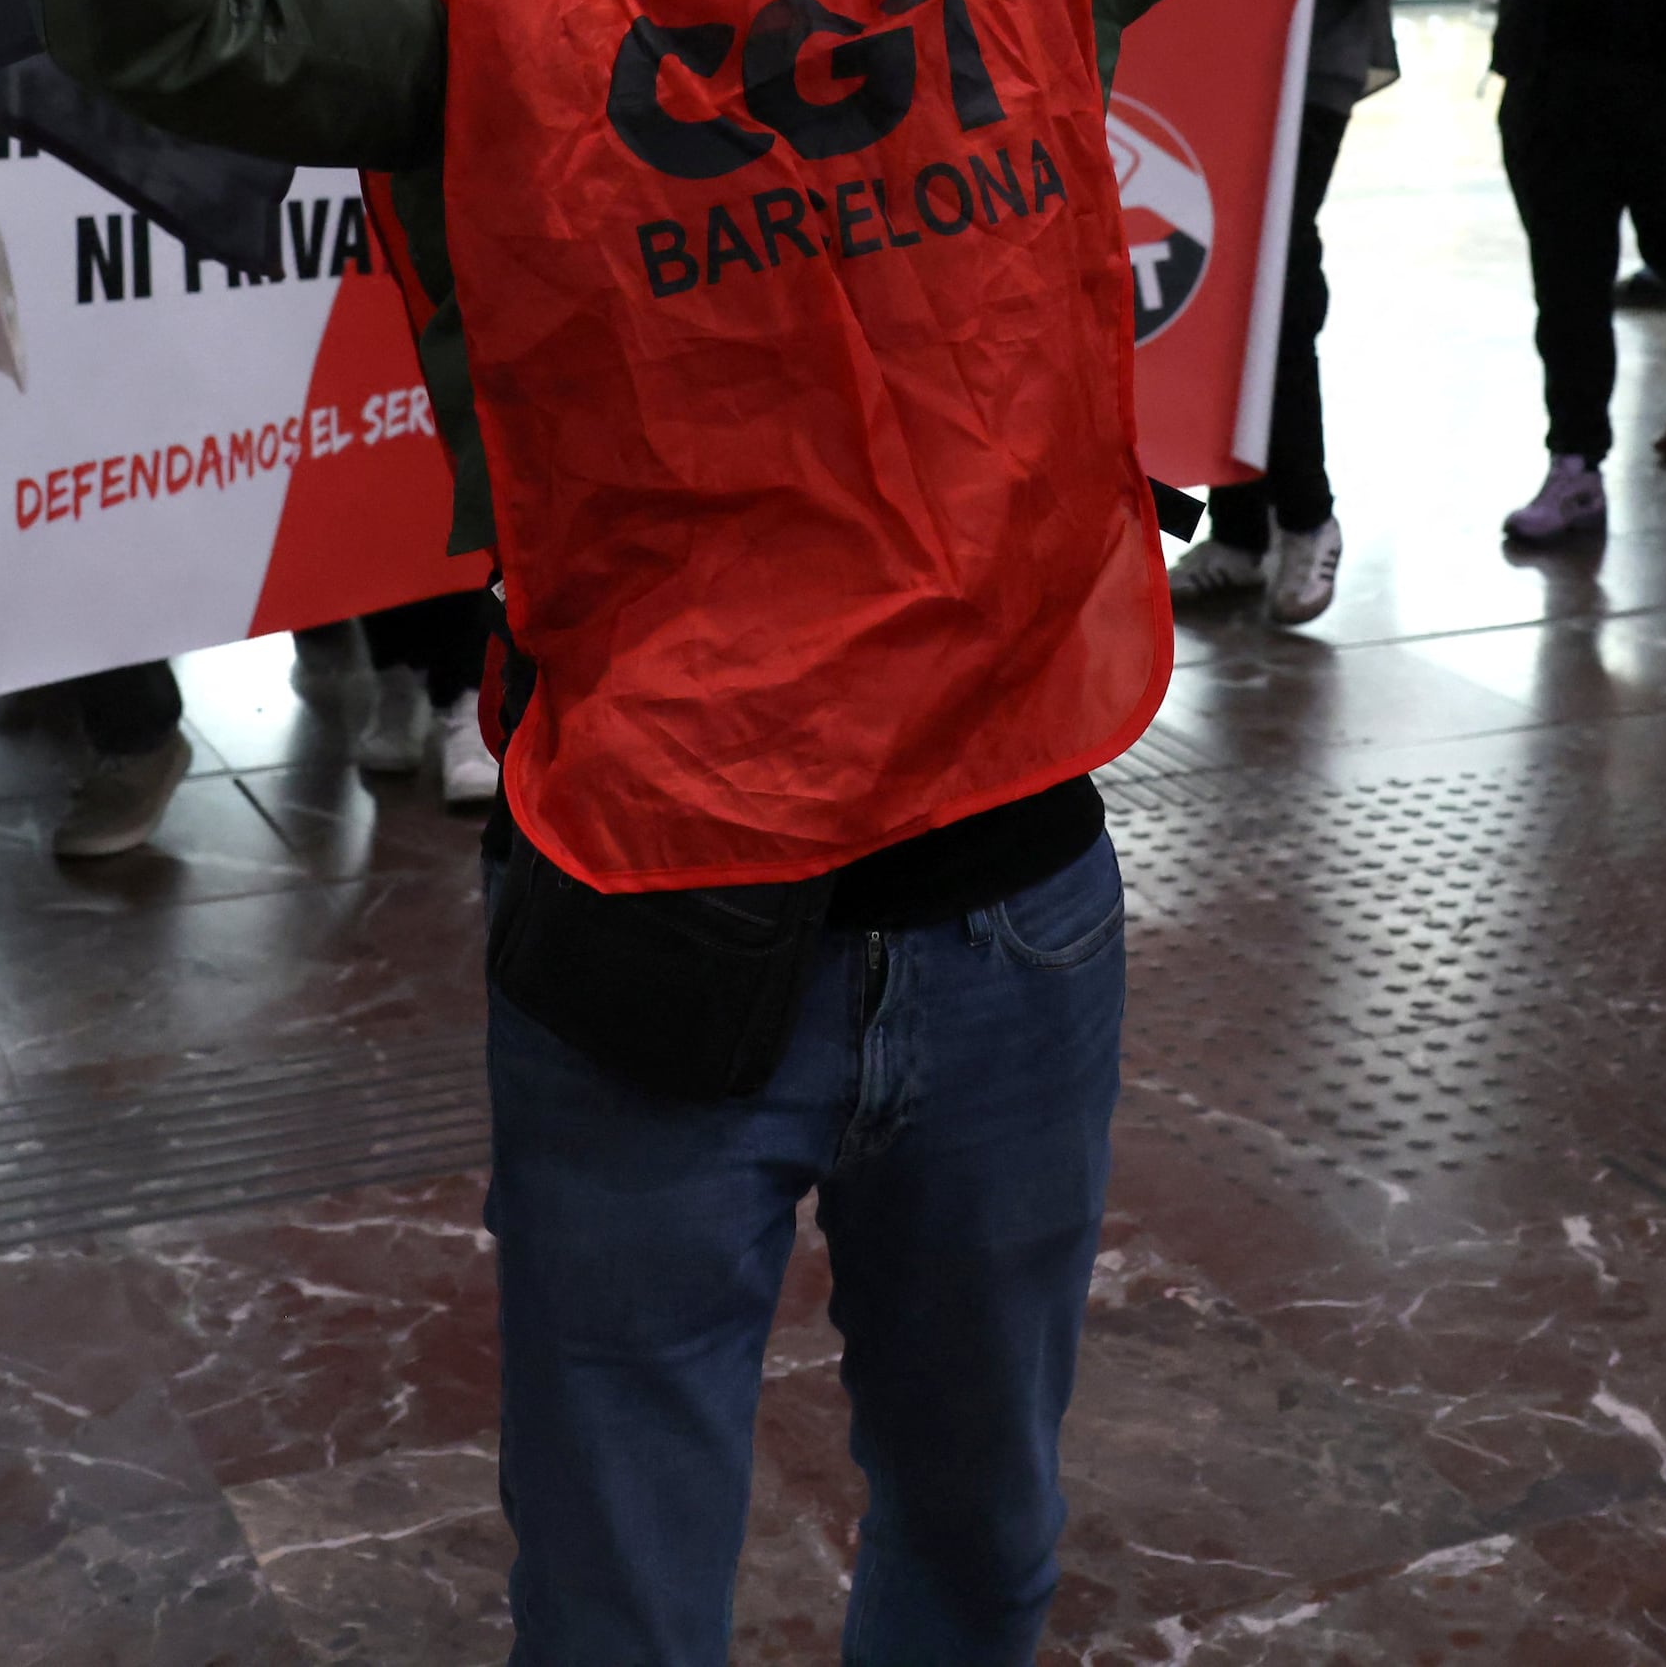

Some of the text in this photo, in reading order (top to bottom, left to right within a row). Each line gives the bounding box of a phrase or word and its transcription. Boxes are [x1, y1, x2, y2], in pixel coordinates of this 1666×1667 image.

[76, 214, 152, 305] NI
[636, 138, 1067, 299] BARELONA
[15, 416, 302, 531] DEFENDAMOS
[309, 405, 354, 460] EL
